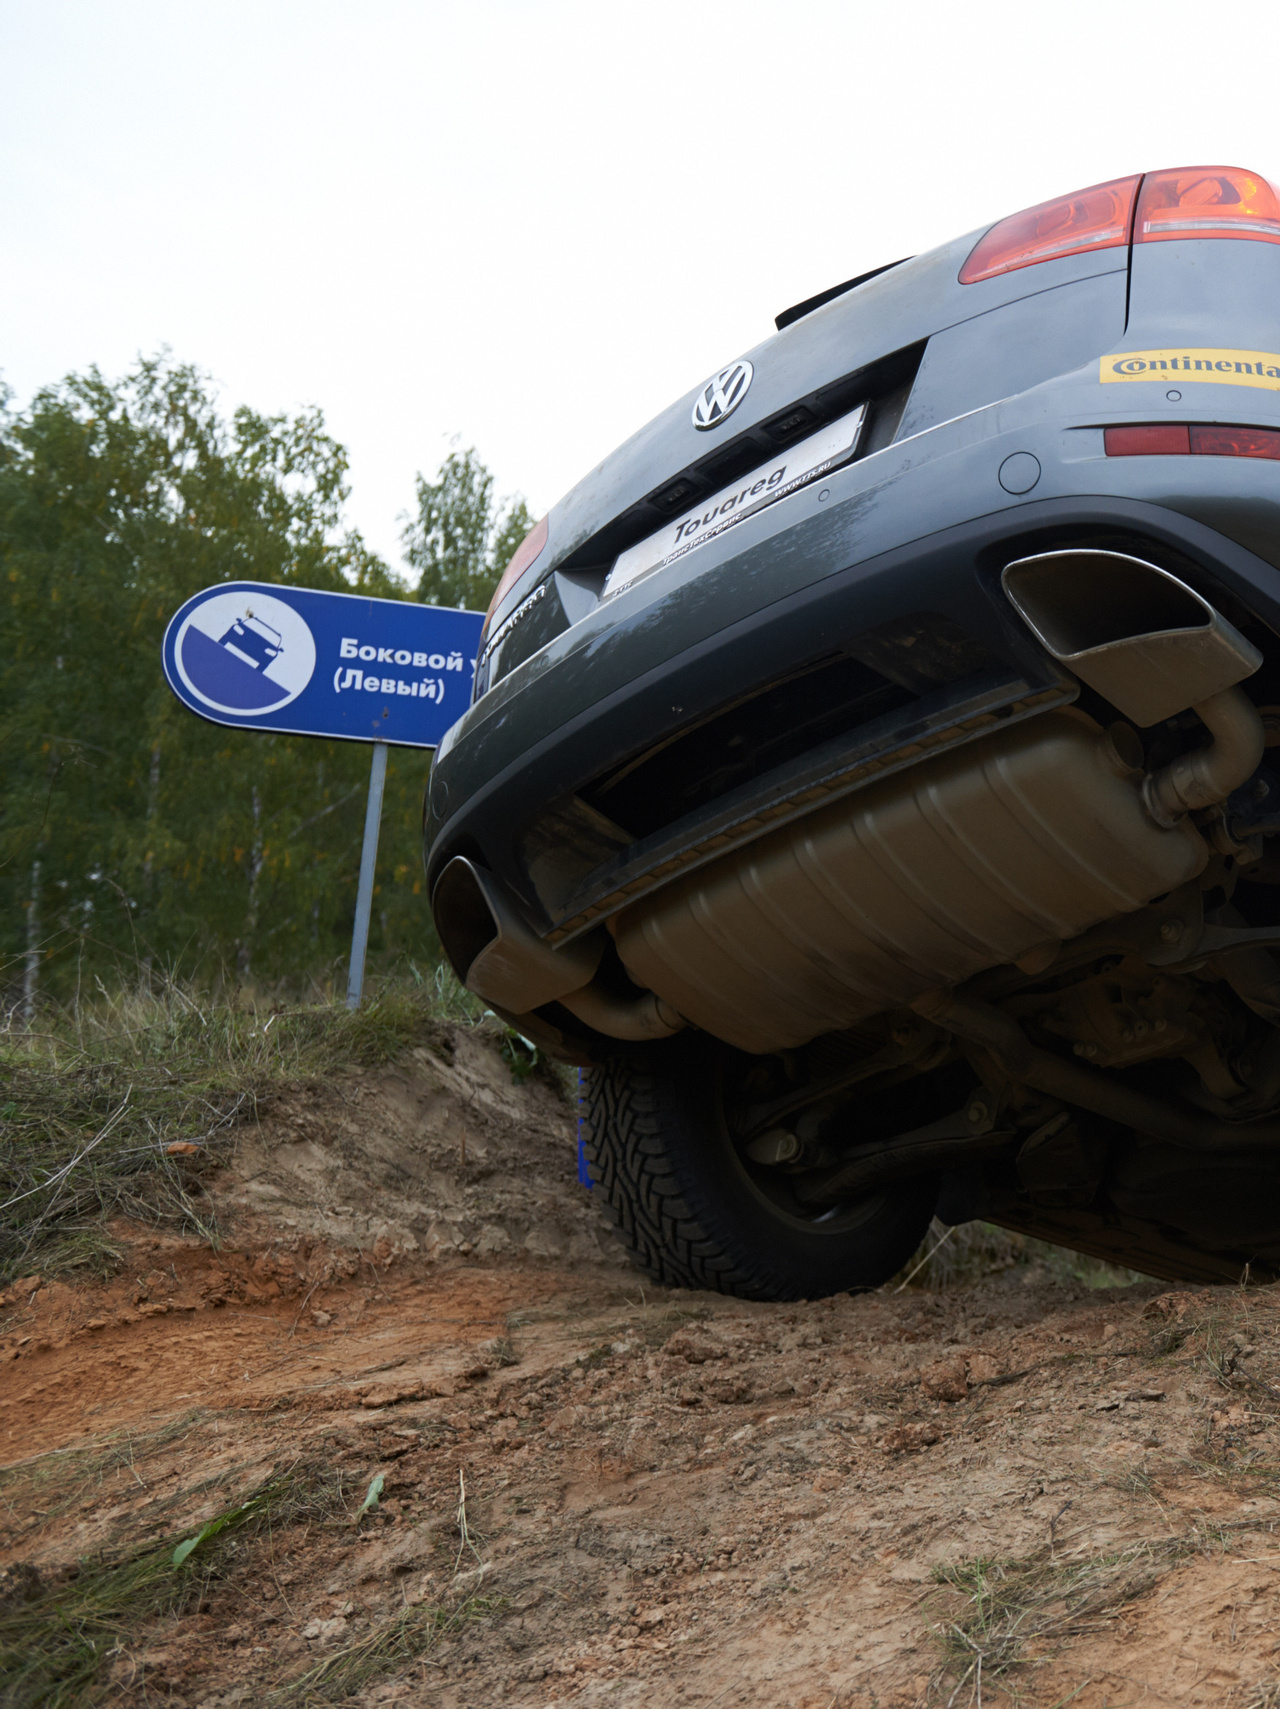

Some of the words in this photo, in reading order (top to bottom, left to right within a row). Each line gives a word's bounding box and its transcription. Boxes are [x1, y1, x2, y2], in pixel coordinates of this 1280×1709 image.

[673, 465, 788, 544] Touareg
[339, 637, 464, 672] Боковой
[333, 666, 445, 705] (Левый)
